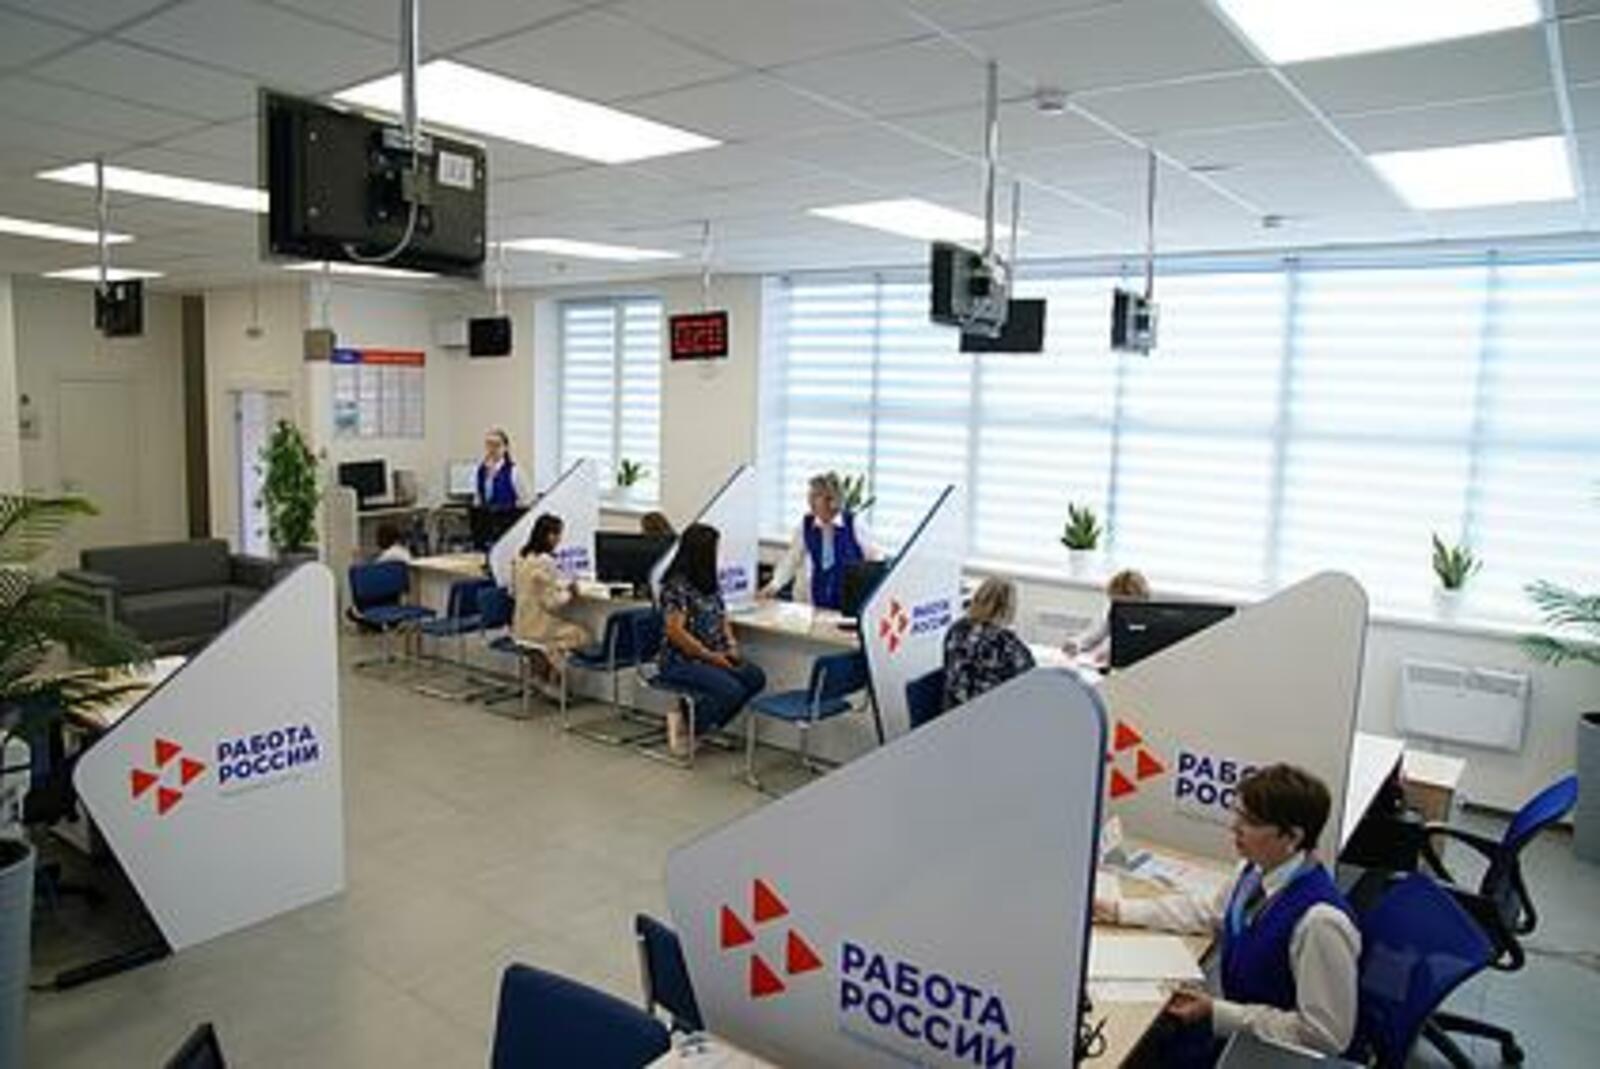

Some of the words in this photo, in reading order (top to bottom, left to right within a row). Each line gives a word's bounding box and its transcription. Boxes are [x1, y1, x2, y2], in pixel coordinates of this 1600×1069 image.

[217, 724, 315, 762] РАБОТА
[217, 743, 319, 785] РОССИИ
[1178, 752, 1258, 785] РАБ
[1176, 776, 1237, 811] РОС
[841, 942, 1010, 1035] РАБОТА
[840, 979, 1017, 1069] РОССИИ
